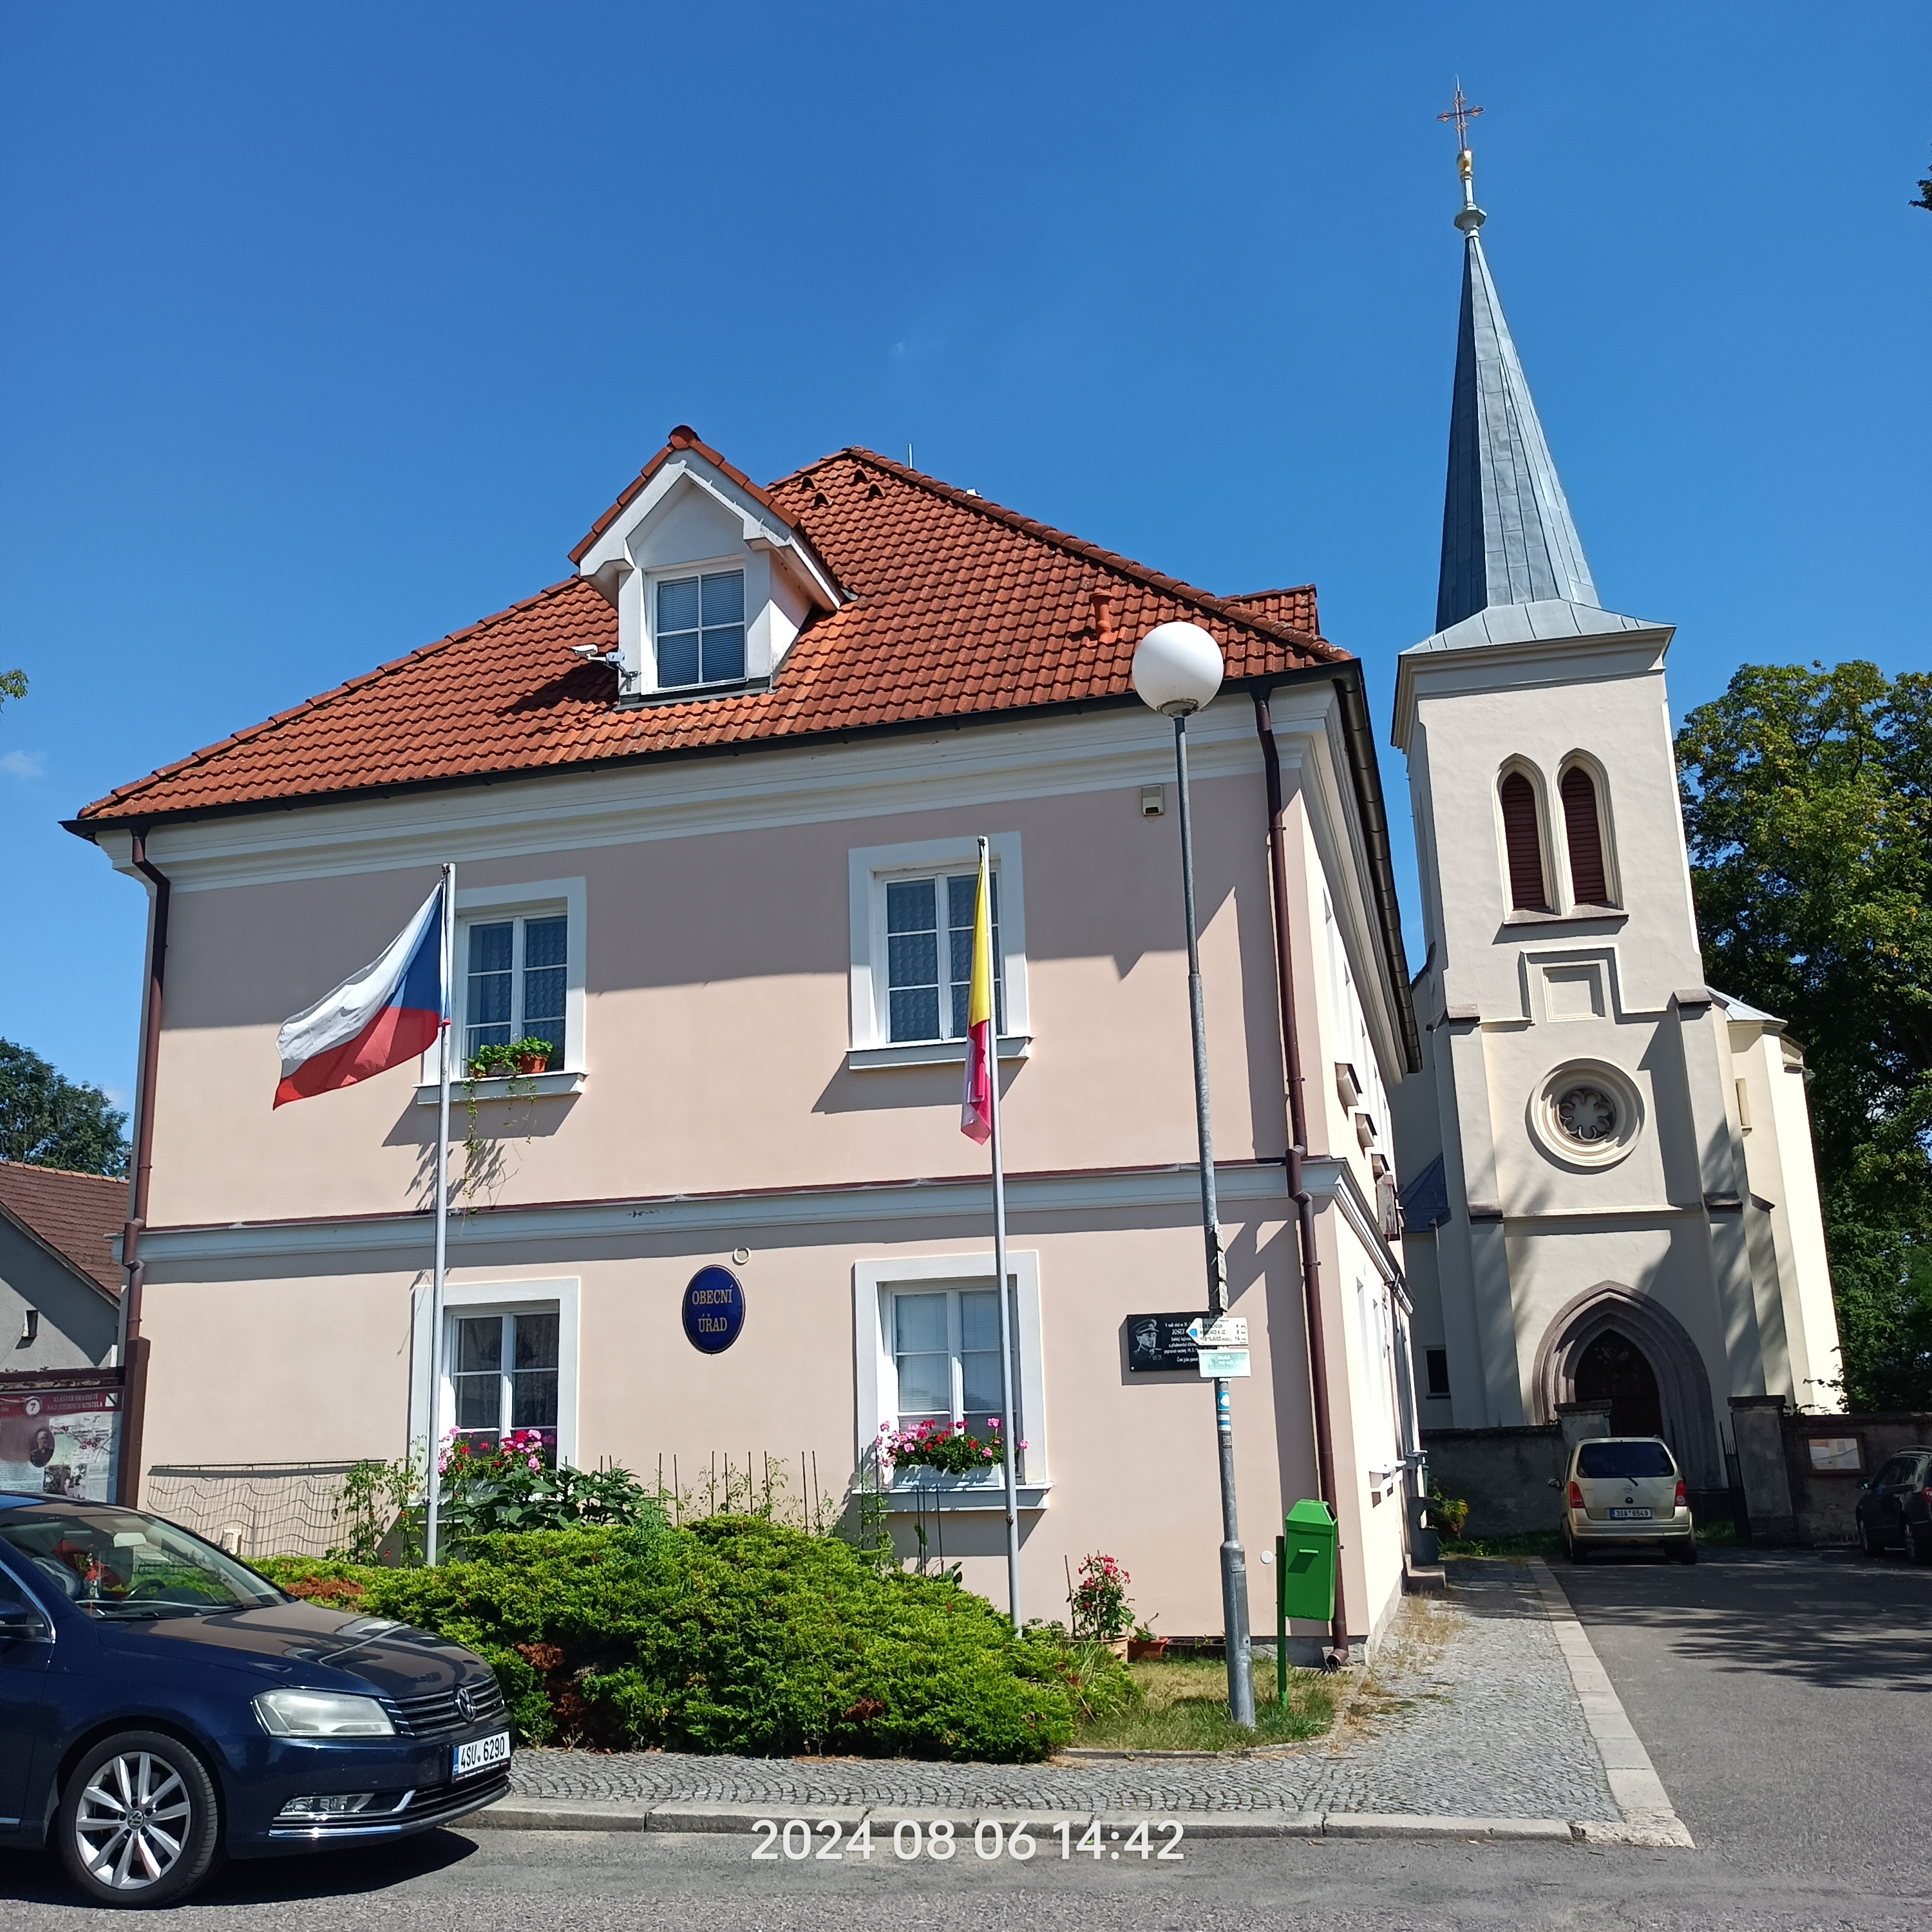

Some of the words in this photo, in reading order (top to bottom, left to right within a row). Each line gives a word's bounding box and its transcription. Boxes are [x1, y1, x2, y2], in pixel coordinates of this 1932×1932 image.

[692, 1283, 734, 1305] OBECNÍ
[697, 1313, 727, 1333] ÚŘAD
[30, 1402, 36, 1412] 7
[82, 1401, 103, 1409] KOSTELA
[460, 1744, 477, 1768] 4SU
[483, 1736, 505, 1761] 6290
